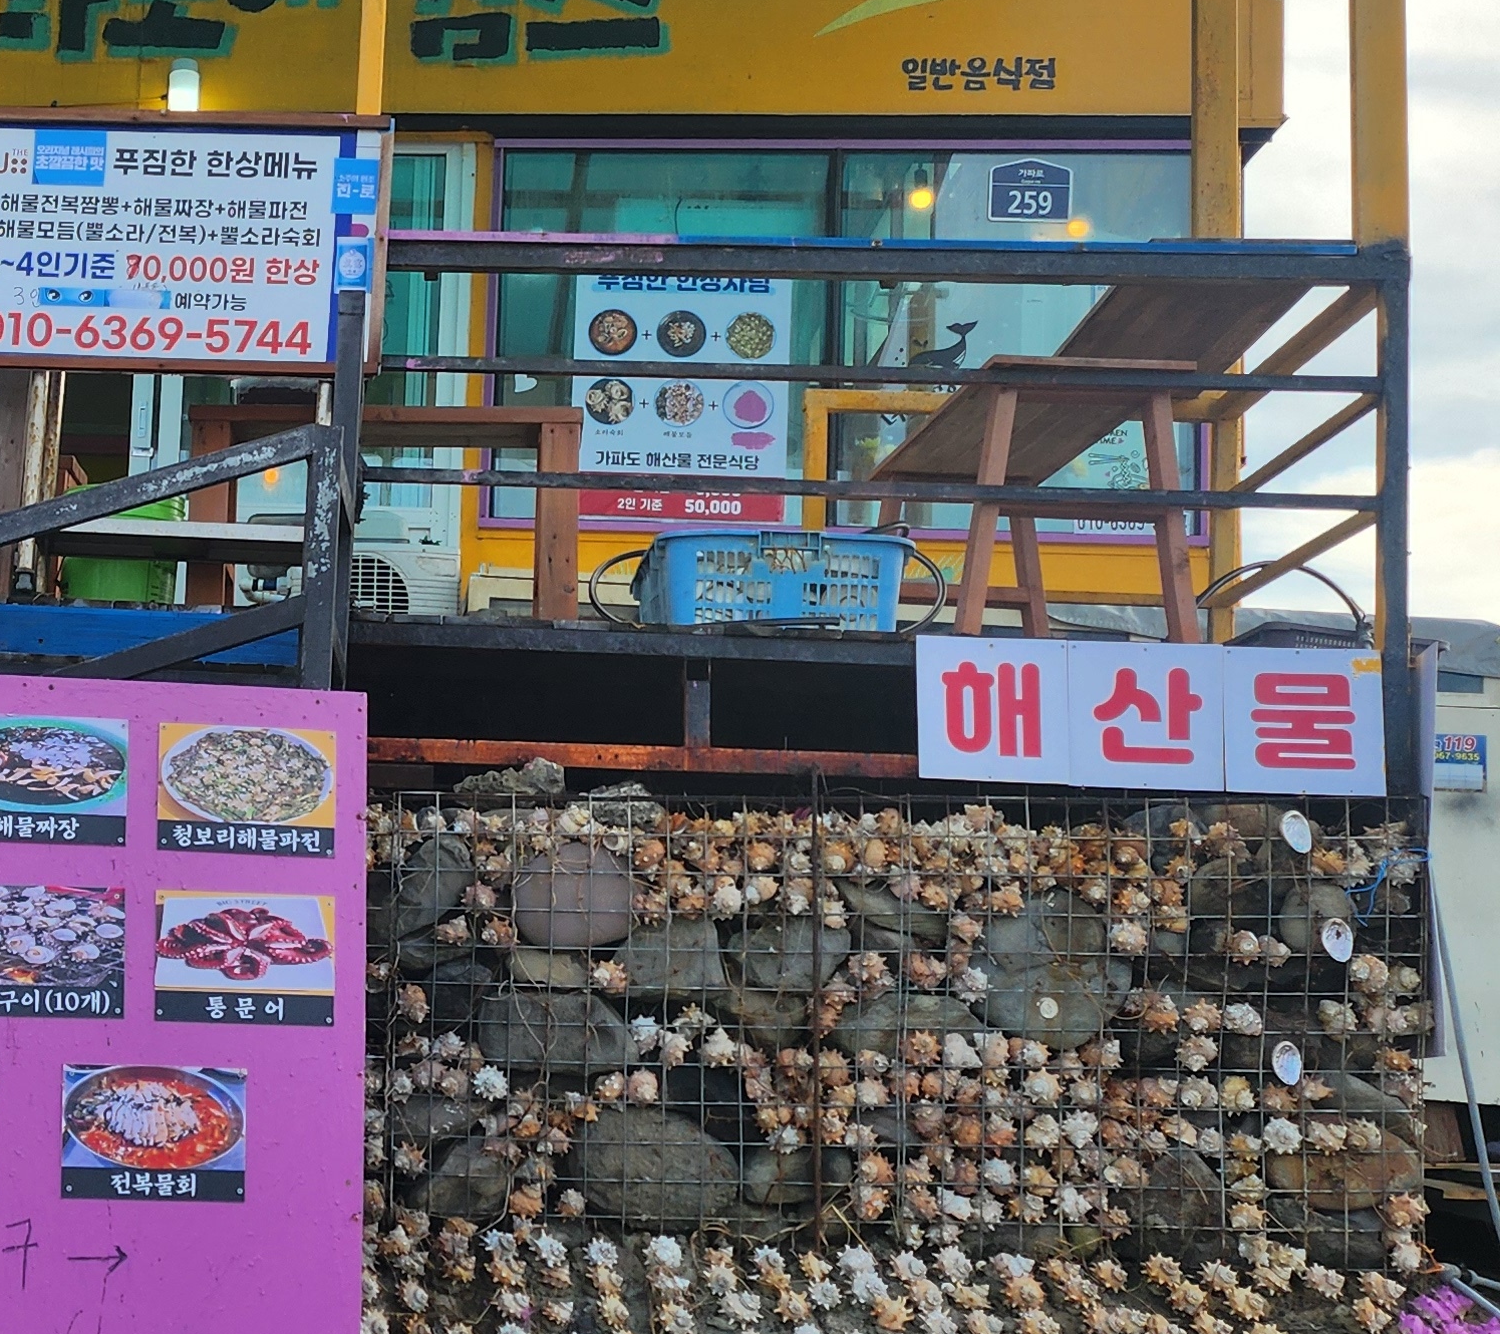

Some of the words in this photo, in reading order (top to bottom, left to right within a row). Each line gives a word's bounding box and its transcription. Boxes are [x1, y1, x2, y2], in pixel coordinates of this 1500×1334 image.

[901, 56, 1057, 91] 일반음식점
[113, 148, 197, 178] 푸짐한
[206, 150, 319, 181] 한상메뉴
[1007, 190, 1052, 215] 259
[265, 257, 320, 286] 한상
[174, 292, 248, 312] 예약가능
[595, 450, 640, 466] 가파도
[646, 451, 691, 468] 해산물
[697, 453, 759, 470] 전문식당
[617, 497, 636, 510] 2인
[640, 498, 663, 512] 기준
[685, 499, 741, 515] 50,000
[1444, 736, 1476, 752] 119
[172, 823, 321, 854] 청보리해물파전
[110, 1173, 198, 1198] 전복물회
